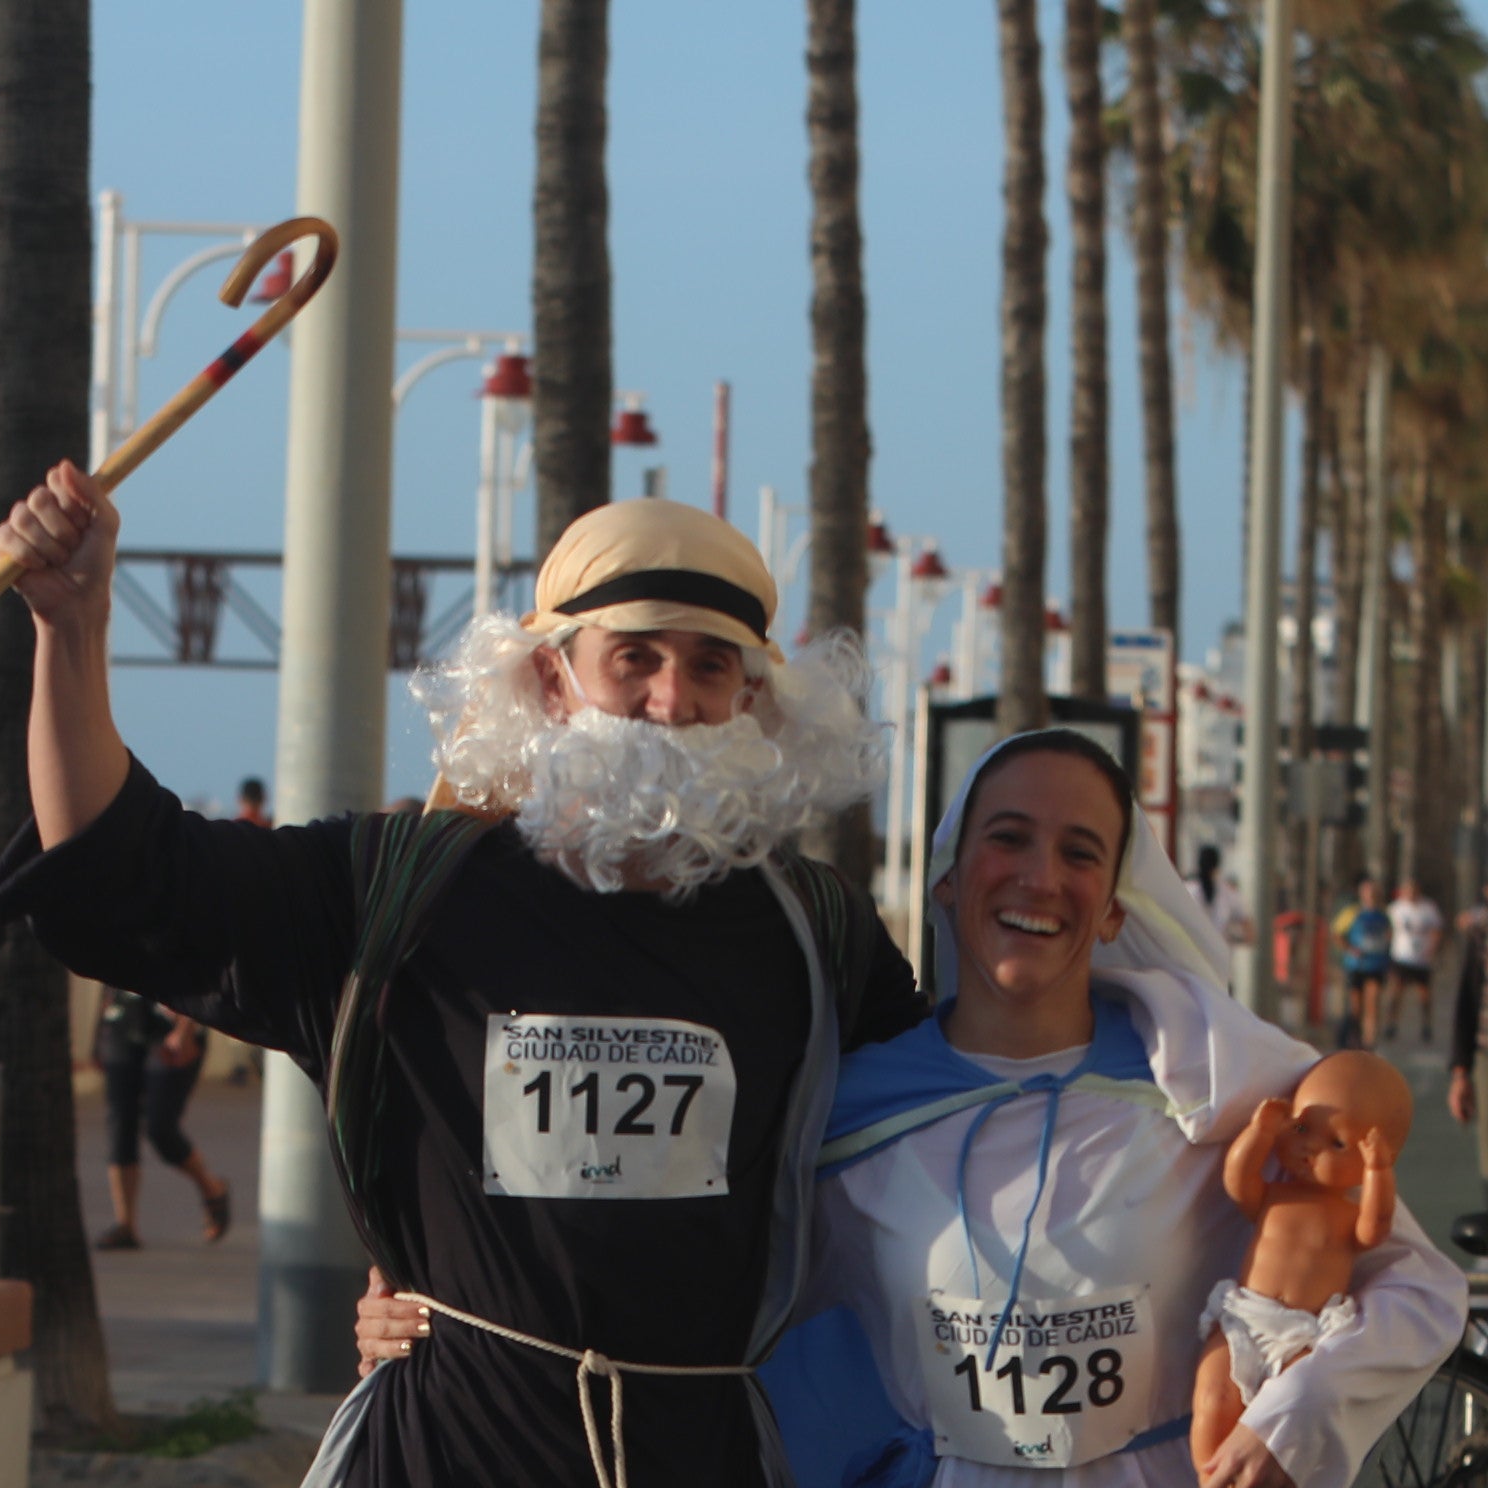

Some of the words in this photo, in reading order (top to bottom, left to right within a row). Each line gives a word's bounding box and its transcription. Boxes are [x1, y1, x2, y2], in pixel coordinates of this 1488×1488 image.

[508, 1026, 562, 1040] SAN
[571, 1028, 712, 1048] SILVESTRE
[508, 1042, 601, 1062] CIUDAD
[608, 1044, 641, 1064] DE
[523, 1072, 704, 1136] 1127
[931, 1309, 982, 1326] SAN
[935, 1325, 1021, 1346] CIUDD
[1029, 1328, 1062, 1348] DE
[955, 1348, 1124, 1415] 1128
